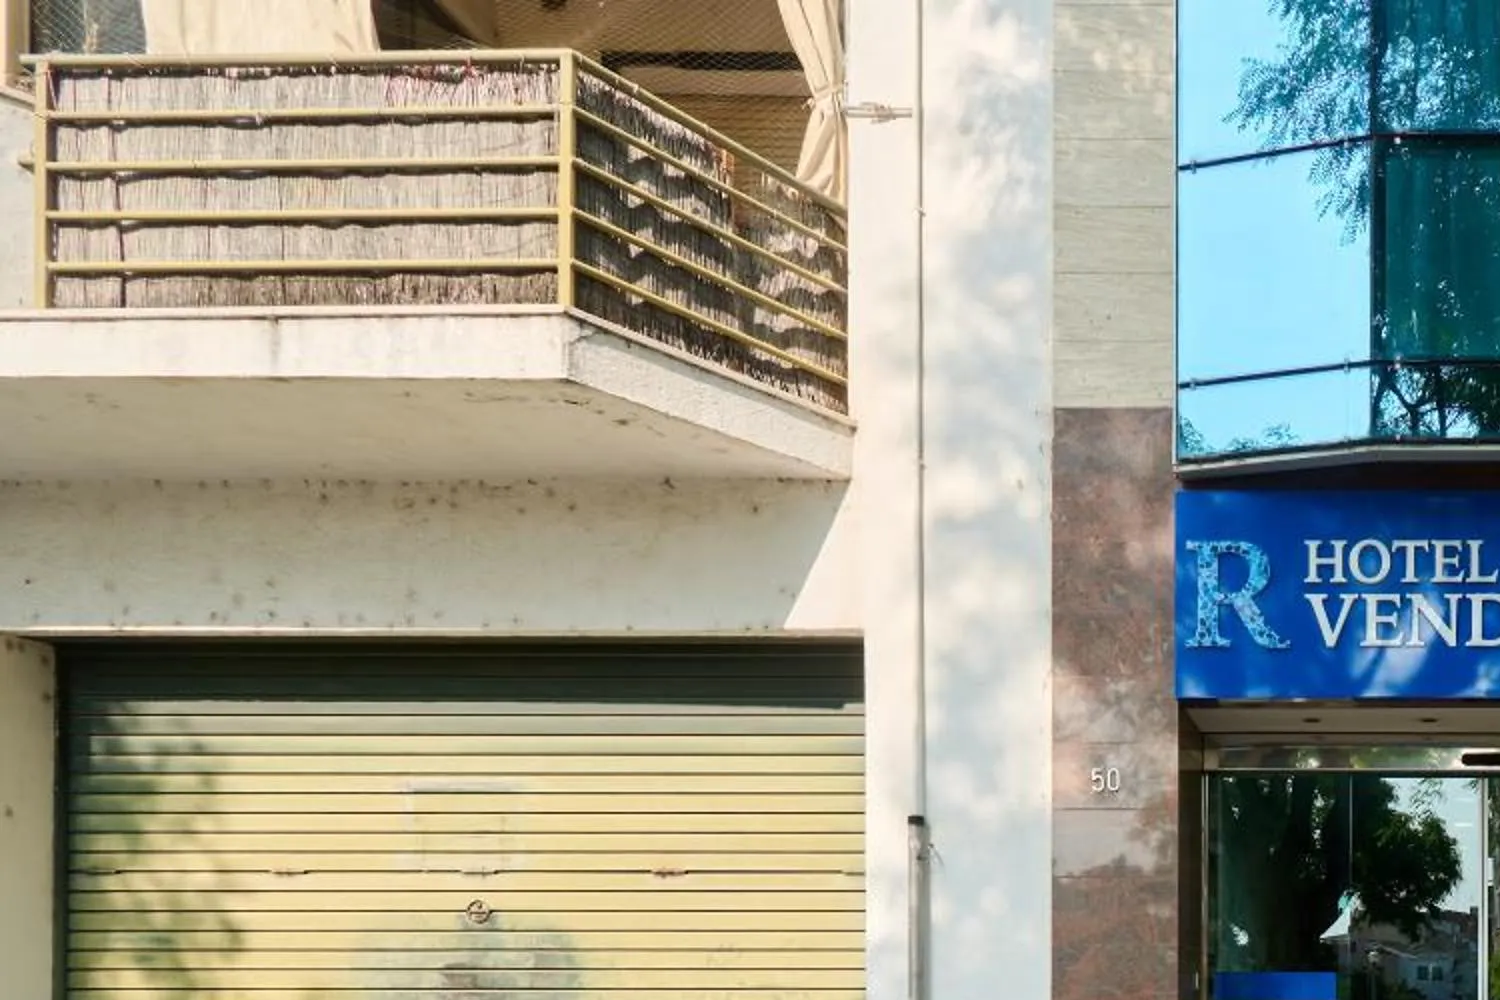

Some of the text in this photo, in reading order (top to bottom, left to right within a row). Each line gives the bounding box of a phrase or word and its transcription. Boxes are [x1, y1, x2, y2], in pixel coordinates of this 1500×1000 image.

[1304, 539, 1498, 583] HOTEL
[1186, 541, 1291, 648] R
[1091, 767, 1121, 792] 50
